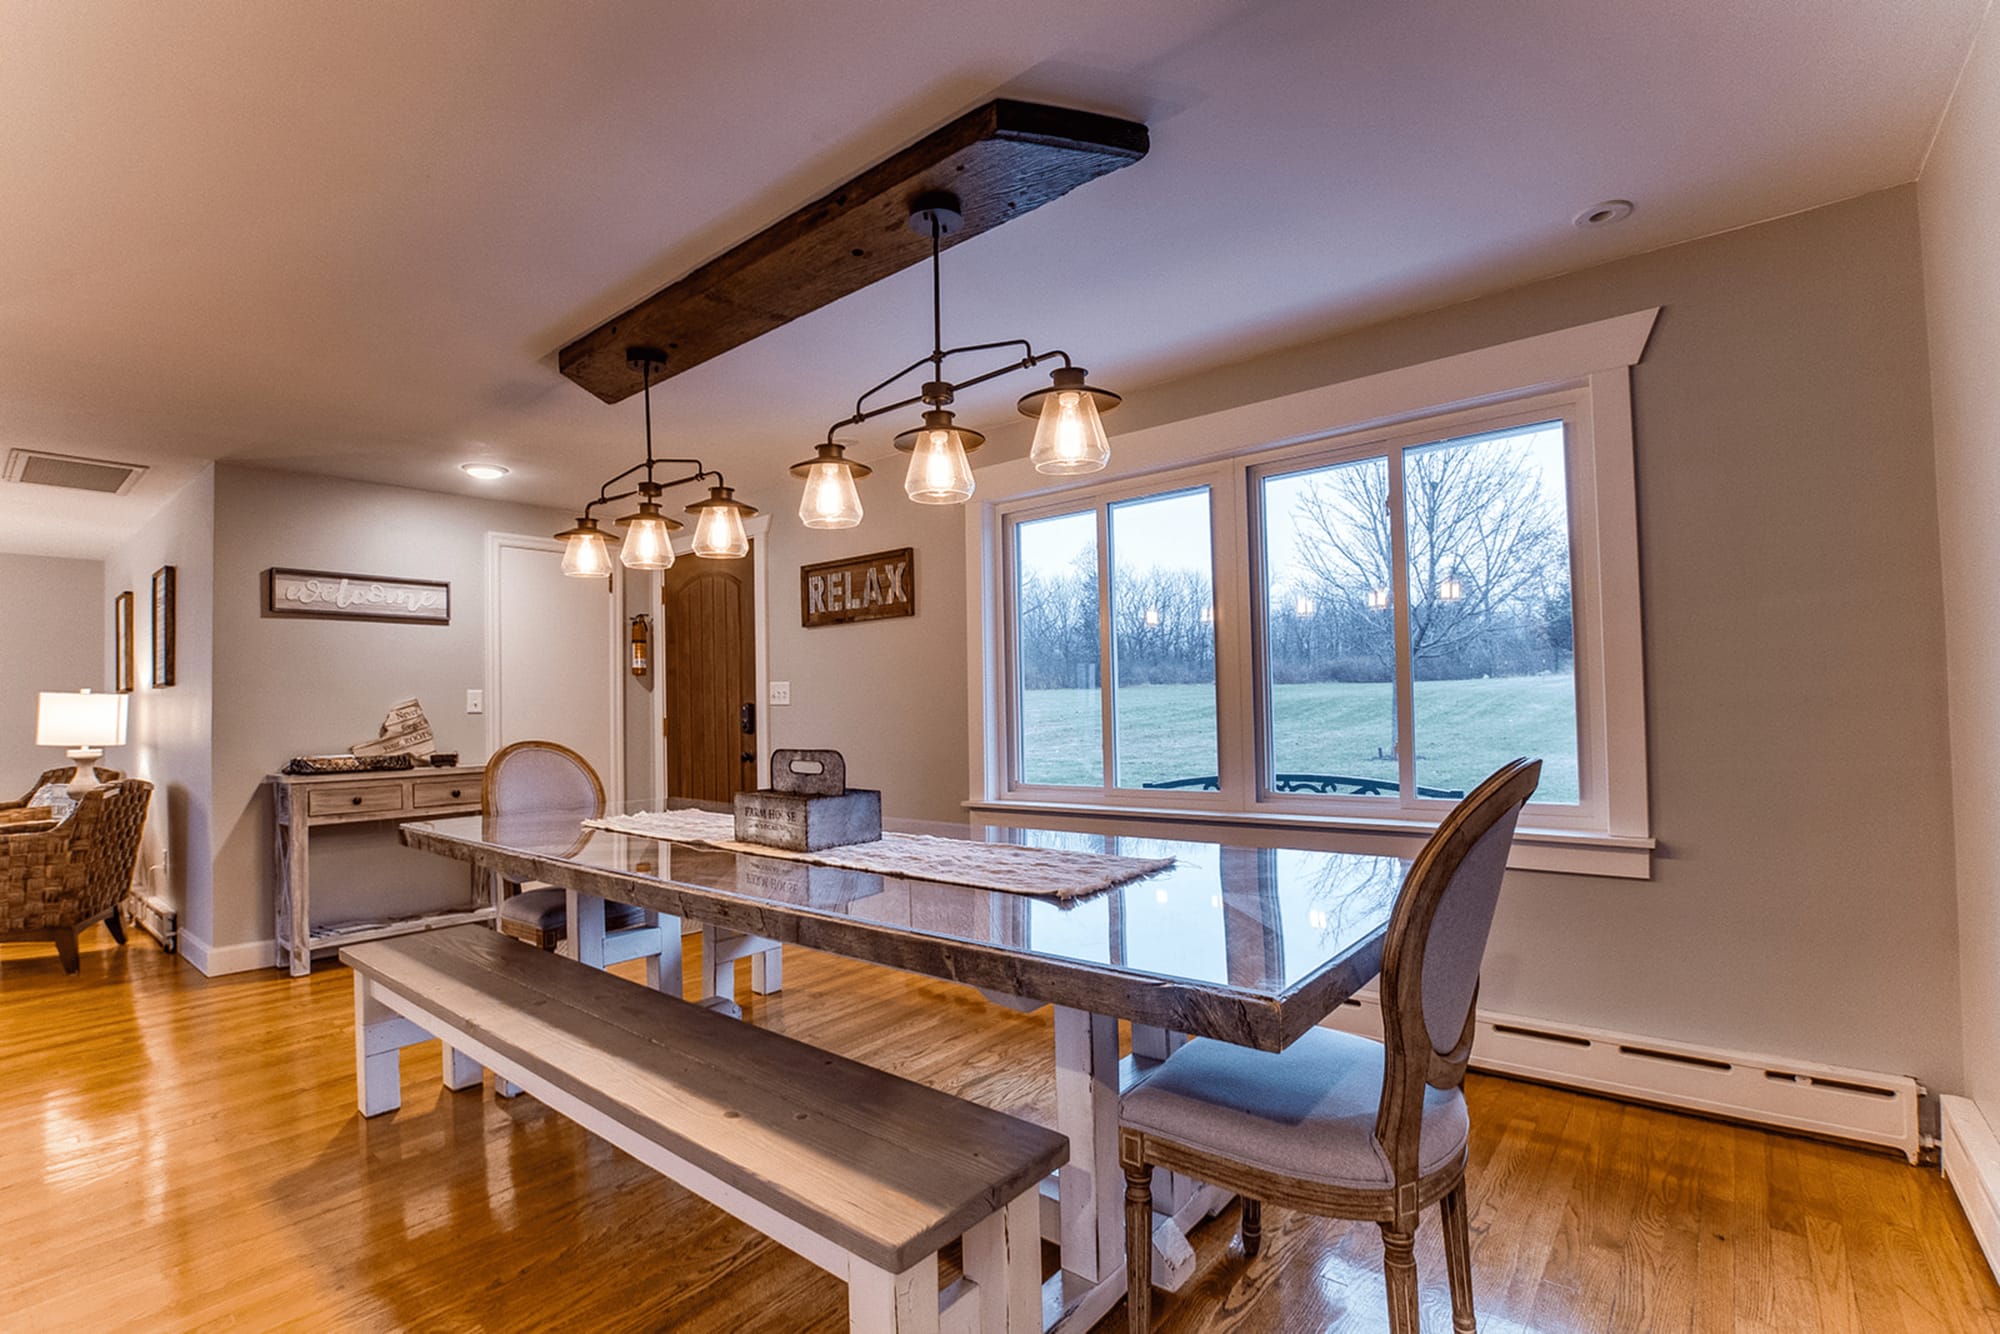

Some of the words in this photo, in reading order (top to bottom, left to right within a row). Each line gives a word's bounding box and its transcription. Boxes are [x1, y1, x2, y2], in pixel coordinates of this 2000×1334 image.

[285, 578, 437, 612] welcome
[808, 562, 907, 614] RELAX
[395, 709, 420, 720] Never
[744, 806, 767, 819] FARM
